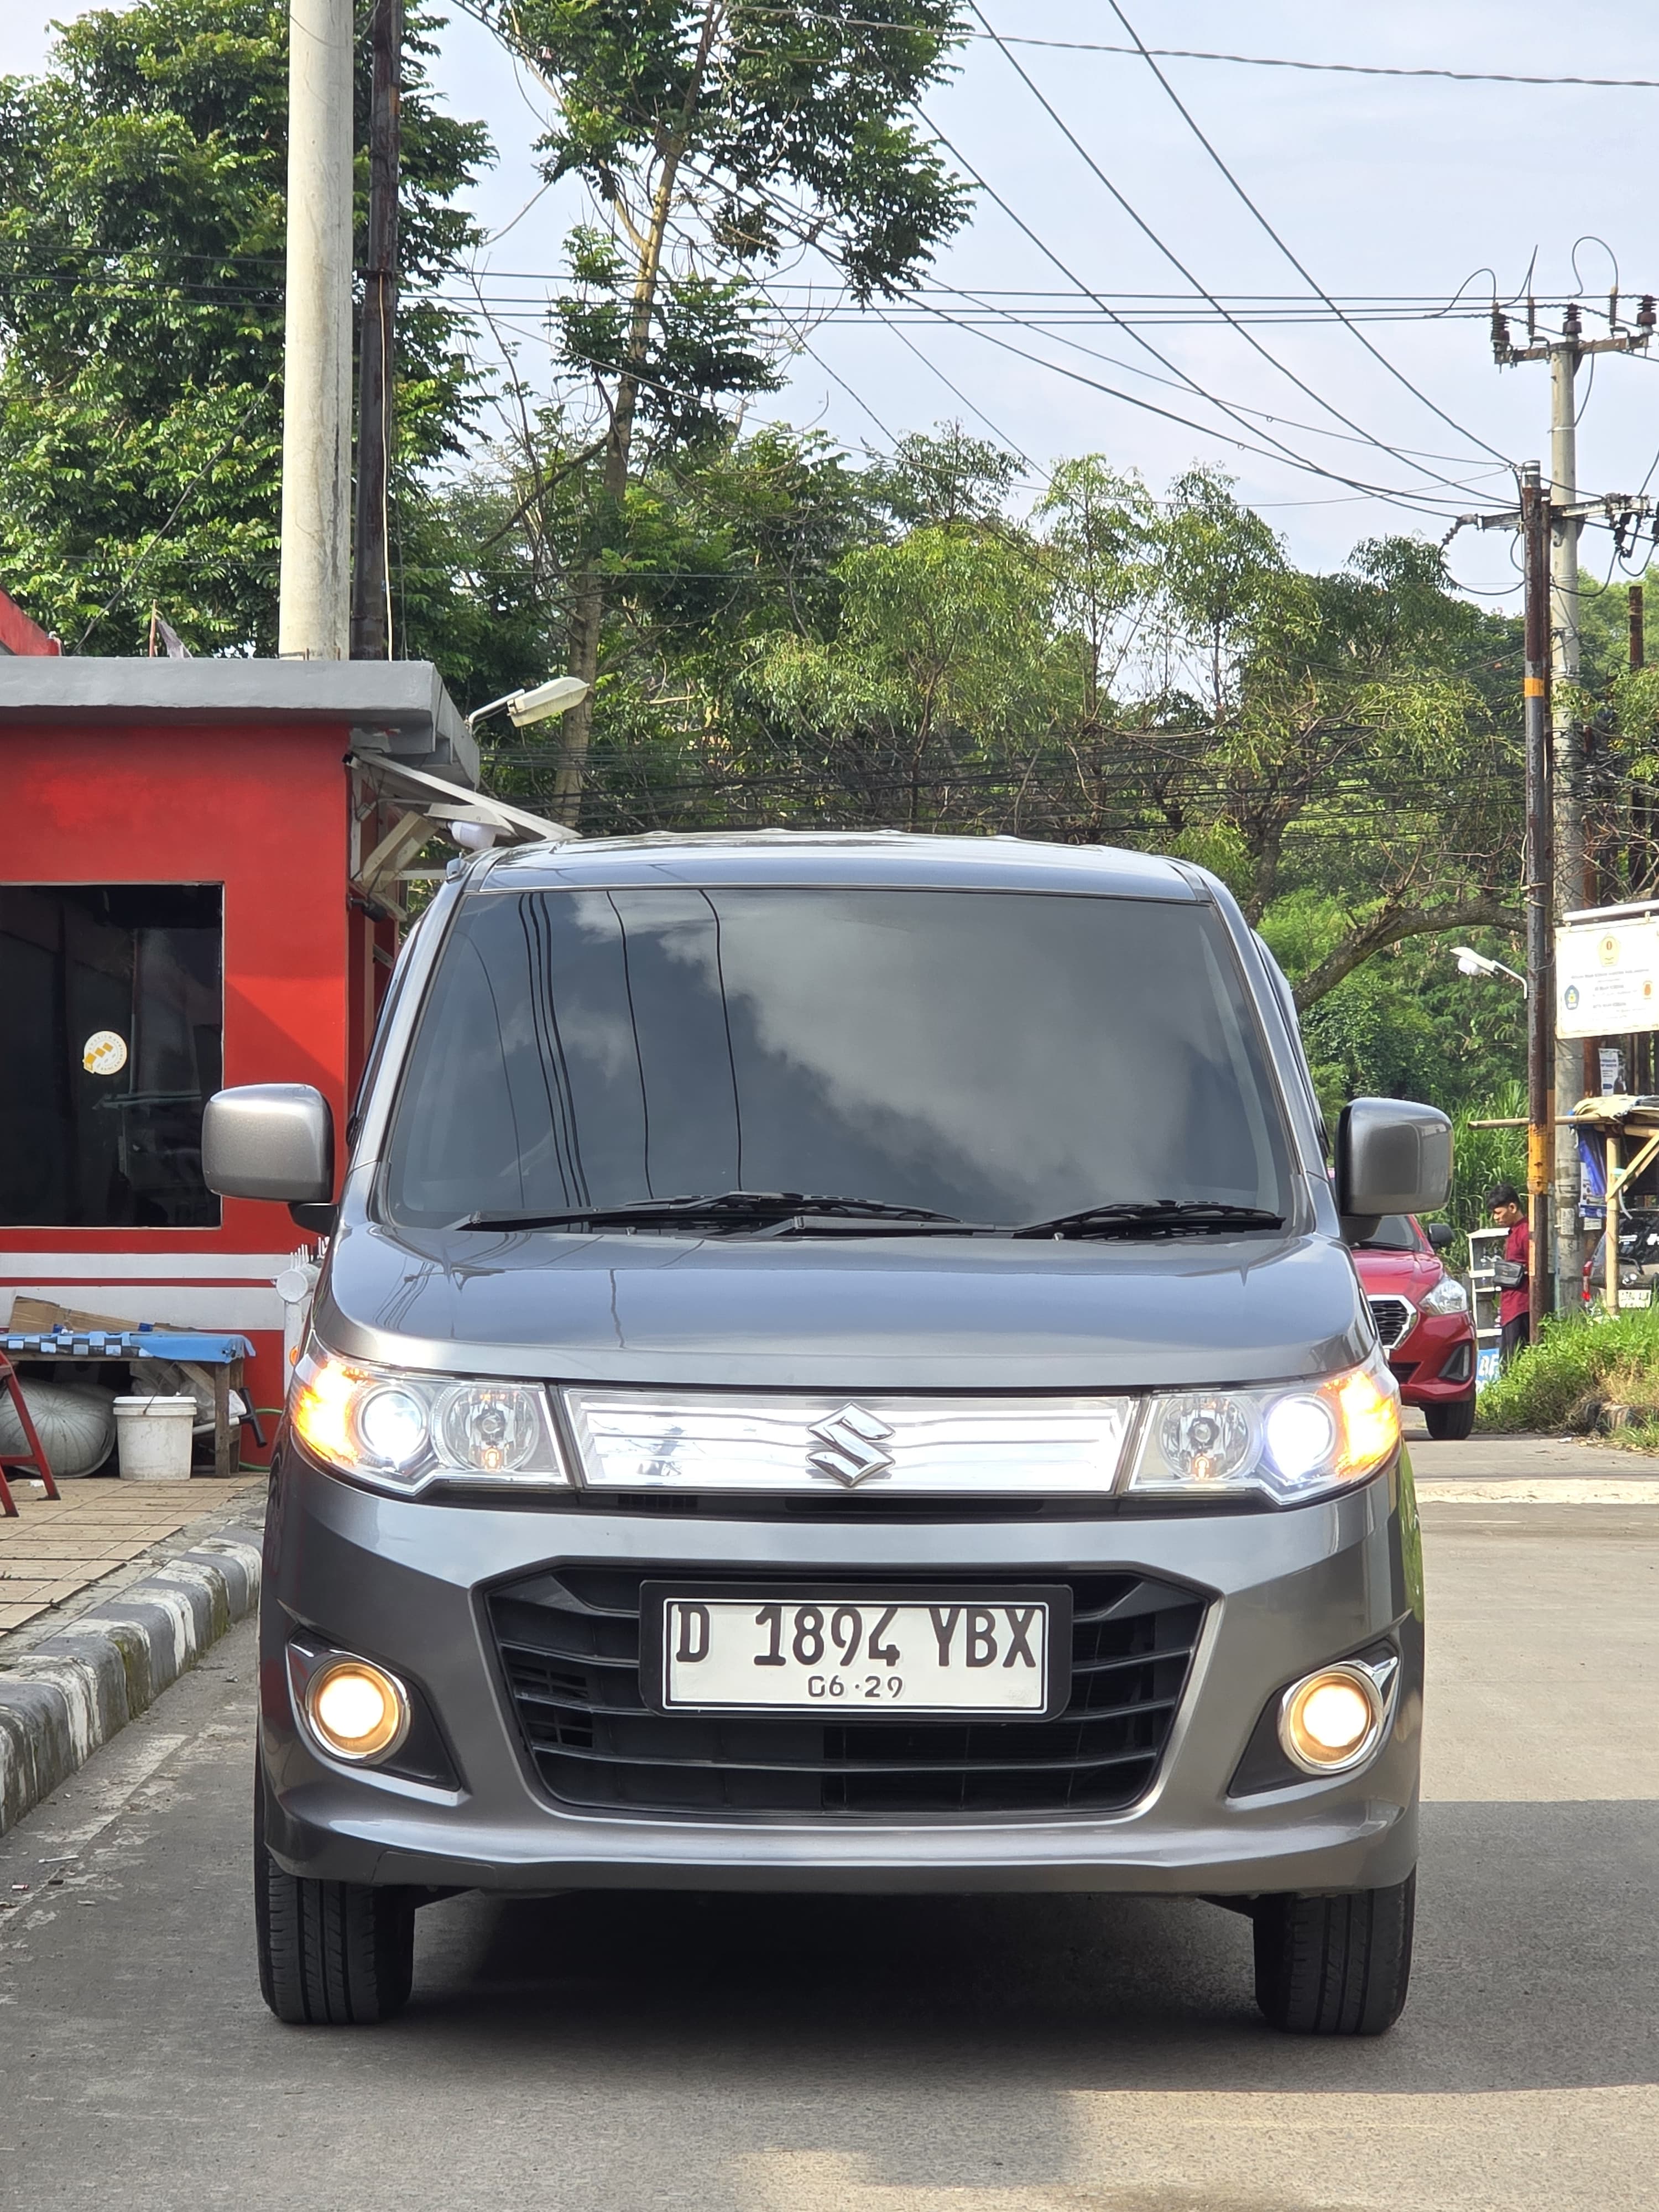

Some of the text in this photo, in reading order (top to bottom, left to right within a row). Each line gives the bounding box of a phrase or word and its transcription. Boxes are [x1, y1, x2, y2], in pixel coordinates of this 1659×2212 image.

[676, 1604, 1036, 1668] D 1894 YBX
